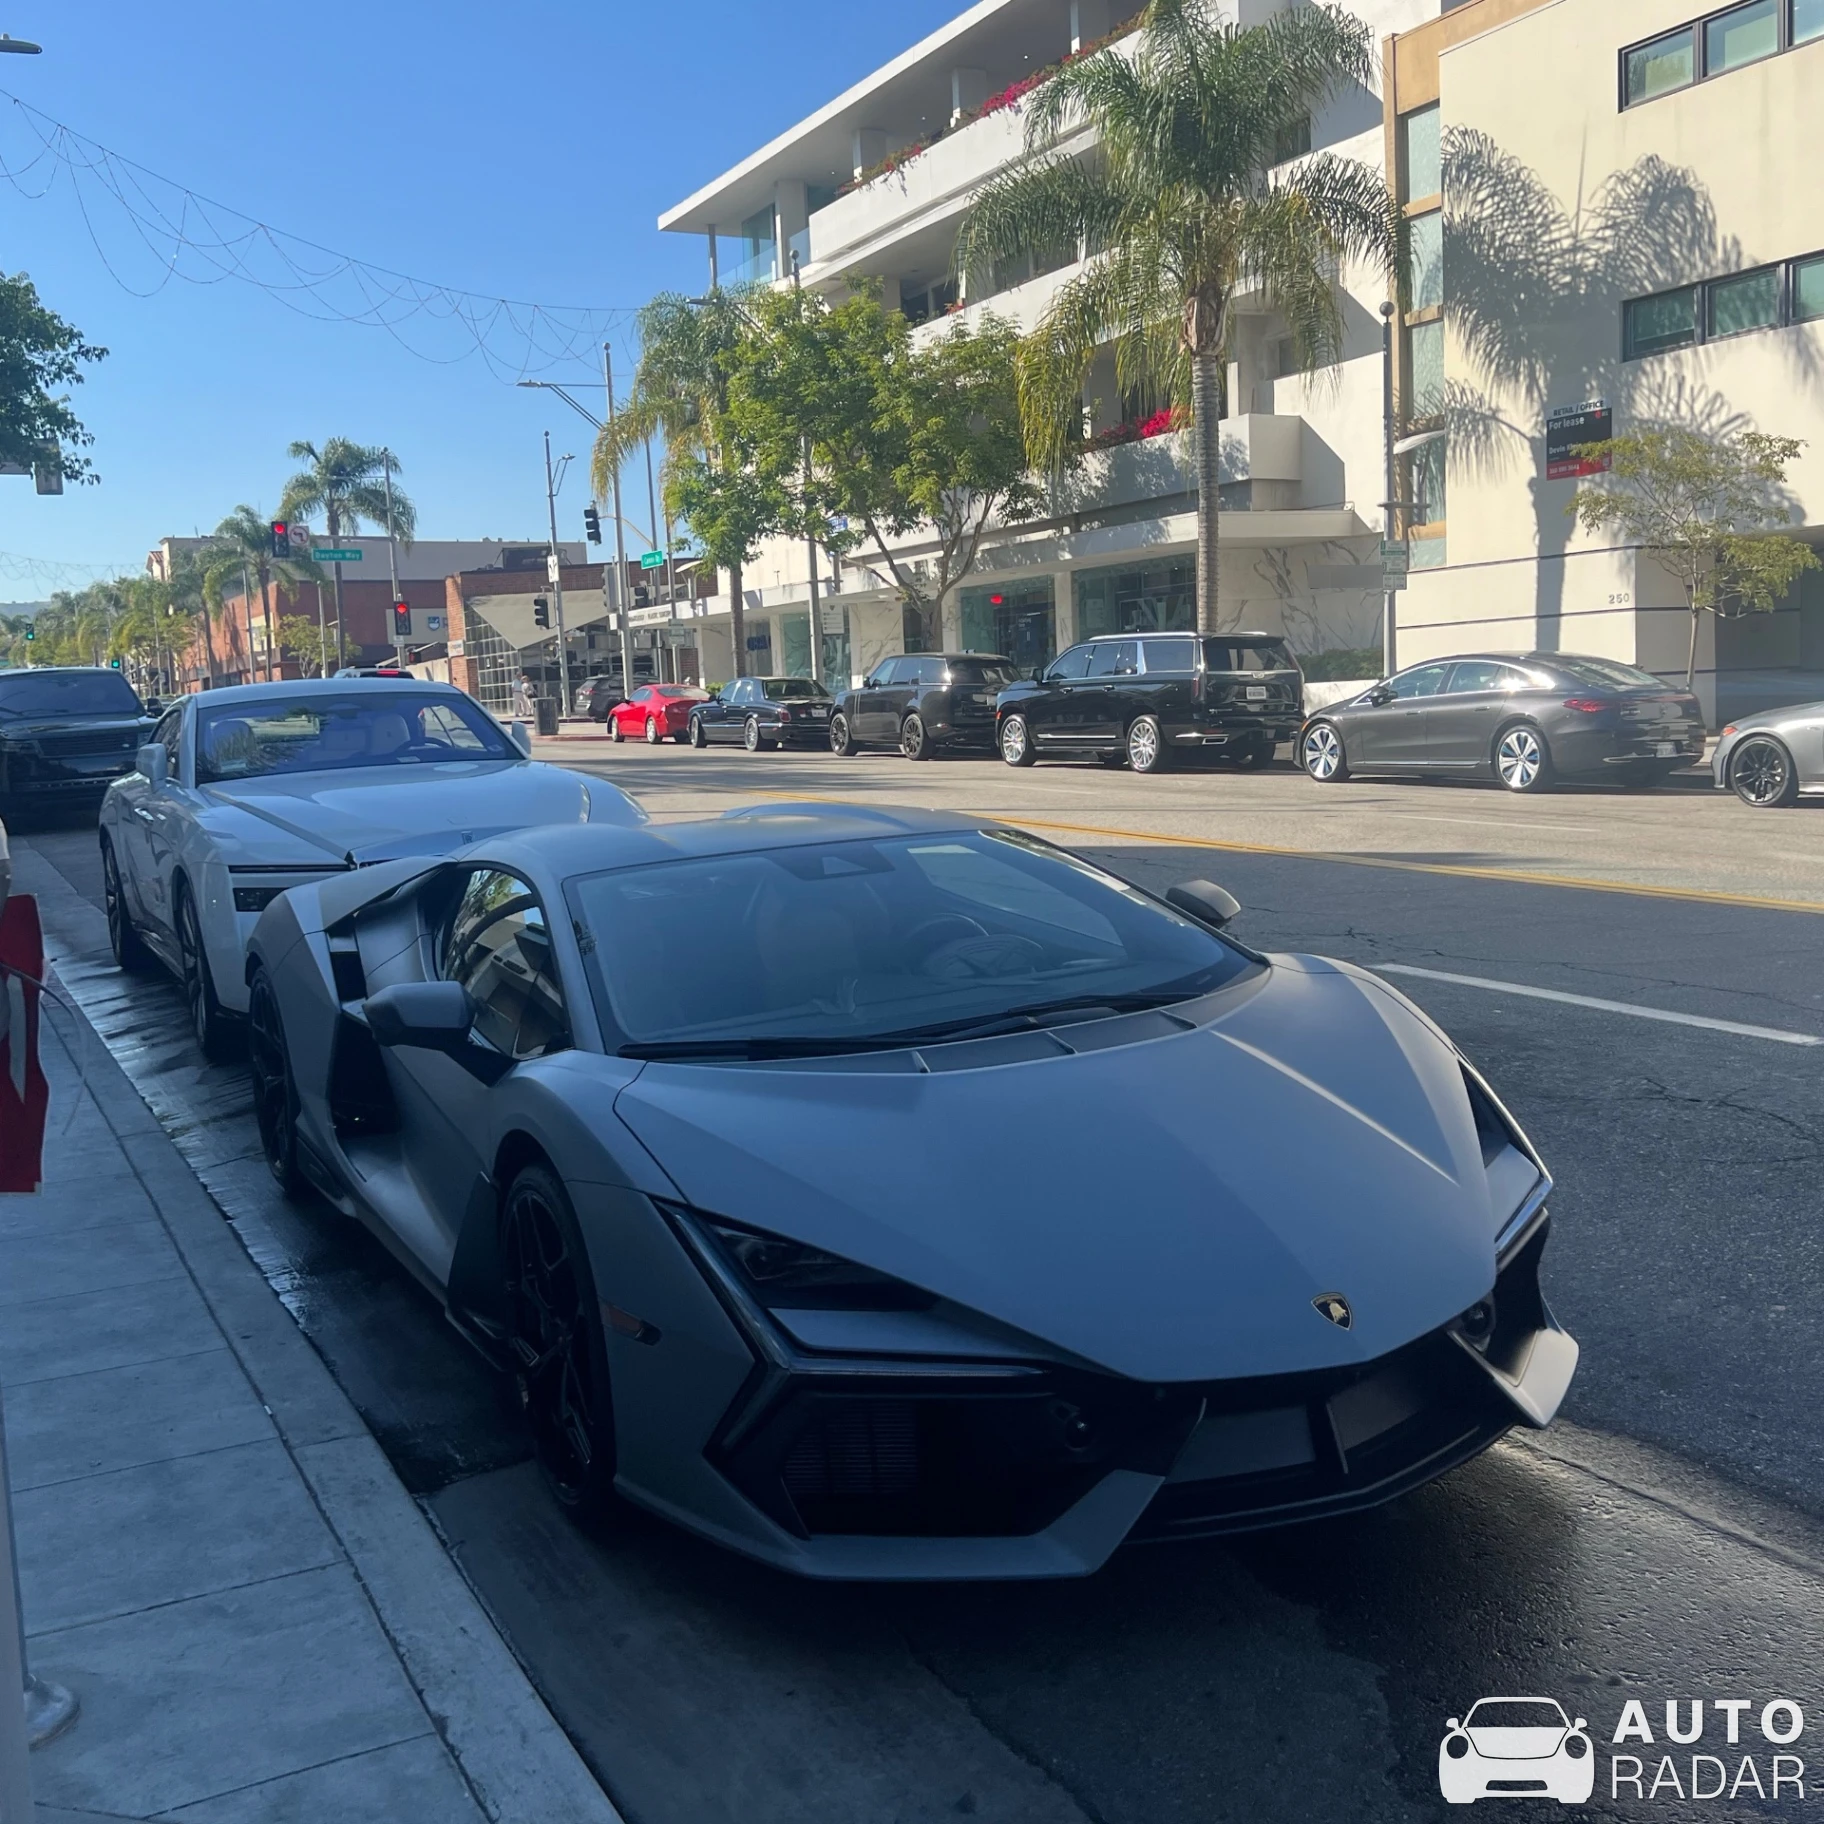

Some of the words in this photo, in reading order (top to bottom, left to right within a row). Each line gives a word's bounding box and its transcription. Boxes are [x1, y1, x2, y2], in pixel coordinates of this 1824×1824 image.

[1553, 406, 1574, 416] RETAIL
[1580, 401, 1604, 411] OFFICE
[1549, 420, 1562, 431] For
[1563, 416, 1585, 428] lease
[315, 552, 343, 560] Dayton
[345, 551, 361, 560] Way
[1608, 592, 1630, 604] 250
